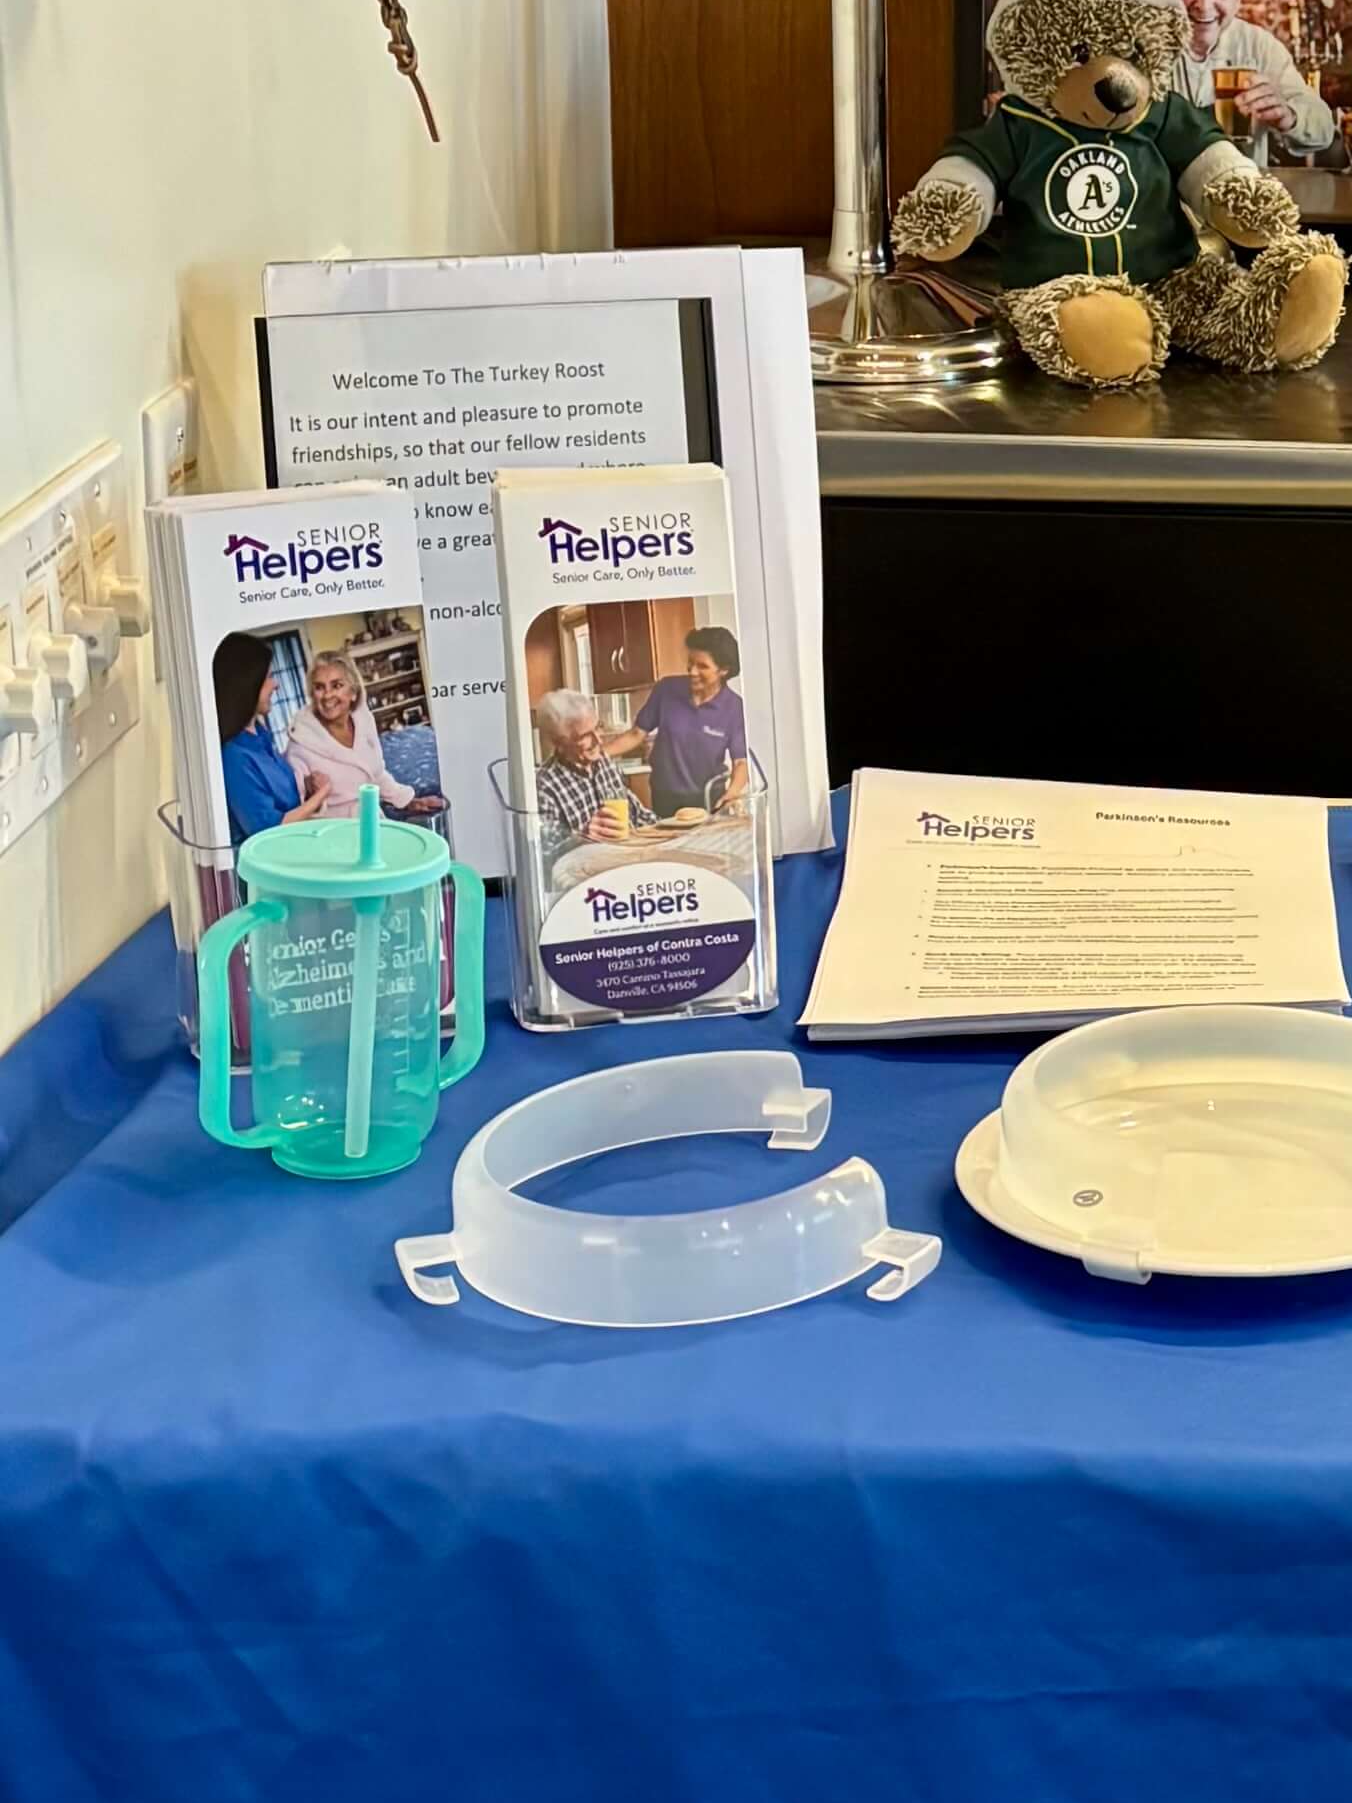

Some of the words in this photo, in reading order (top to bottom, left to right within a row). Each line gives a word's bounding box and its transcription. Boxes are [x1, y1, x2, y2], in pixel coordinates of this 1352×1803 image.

[1059, 151, 1125, 177] OAKLAND
[1058, 207, 1124, 232] ATHLETICS
[333, 371, 418, 390] Welcome
[423, 369, 446, 386] To
[451, 367, 484, 384] The
[489, 363, 550, 383] Turkey
[555, 362, 605, 379] Roost
[290, 416, 302, 432] It
[308, 415, 321, 431] is
[327, 417, 358, 431] our
[364, 410, 417, 429] intent
[423, 407, 456, 425] and
[462, 404, 538, 427] pleasure
[543, 404, 562, 419] to
[567, 400, 644, 422] promote
[292, 440, 398, 465] friendships,
[402, 445, 423, 457] so
[428, 438, 465, 456] that
[471, 440, 501, 454] our
[506, 433, 560, 450] fellow
[565, 429, 646, 448] residents
[414, 470, 461, 488] adult
[425, 501, 473, 518] know
[609, 513, 691, 533] SENIOR
[297, 523, 380, 547] SENIOR
[437, 537, 447, 548] a
[549, 528, 695, 568] Helpers
[235, 542, 384, 583] Helpers
[553, 572, 589, 584] Senior
[593, 570, 623, 581] Care,
[627, 567, 654, 581] Only
[239, 591, 277, 604] Senior
[280, 587, 312, 599] Care,
[315, 582, 343, 595] Only
[972, 815, 1036, 827] SENIOR
[1096, 811, 1164, 823] Parkinson's
[1168, 816, 1231, 826] Resources
[923, 821, 1035, 841] Helpers
[636, 878, 696, 896] SENIOR
[593, 892, 698, 922] Helpers
[331, 929, 391, 950] Ges
[555, 950, 593, 965] Senior
[597, 945, 644, 961] Helpers
[647, 941, 660, 952] of
[661, 938, 702, 950] Contra
[704, 933, 739, 945] Costa
[650, 984, 666, 995] CA
